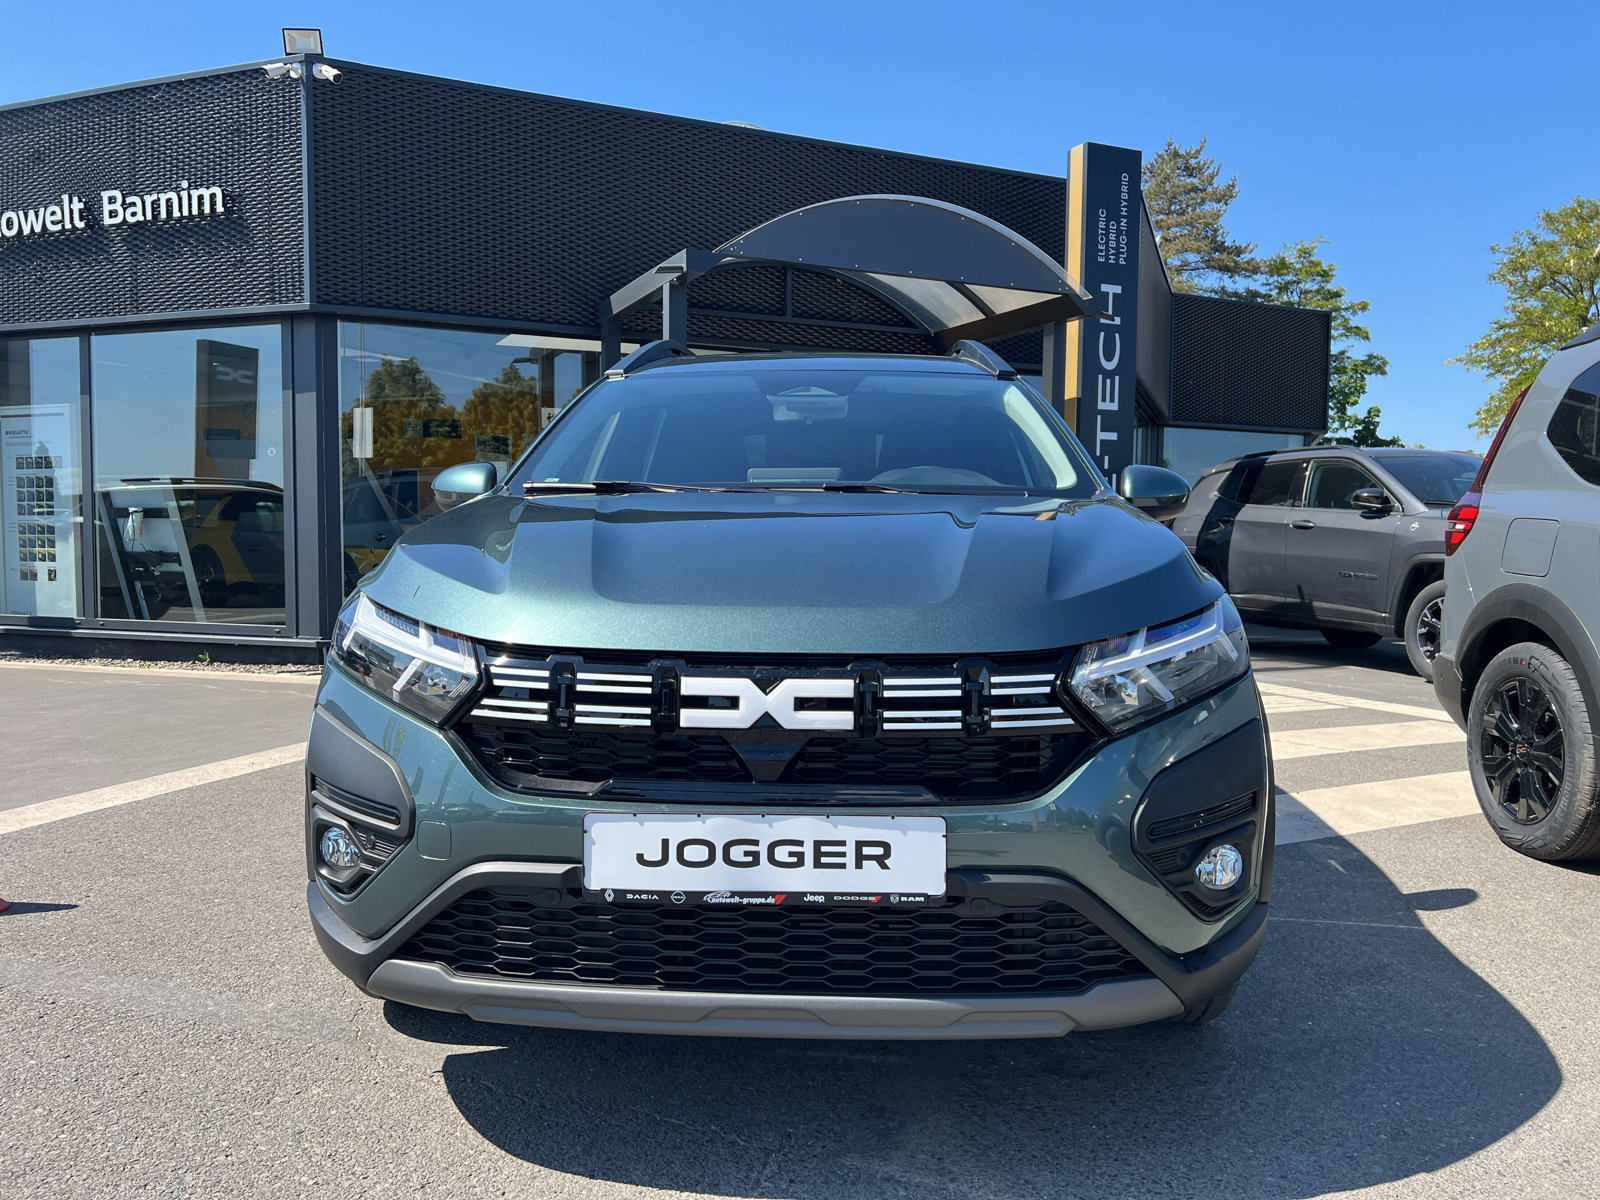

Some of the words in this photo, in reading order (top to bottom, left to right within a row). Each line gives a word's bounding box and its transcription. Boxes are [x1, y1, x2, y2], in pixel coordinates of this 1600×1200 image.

[0, 194, 85, 237] owelt
[100, 180, 225, 226] Barnim
[1120, 172, 1129, 216] HYBRID
[1097, 208, 1107, 263] ELECTRIC
[1108, 220, 1117, 264] HYBRID
[1119, 218, 1128, 265] PLUG-IN
[635, 837, 892, 870] JOGGER
[803, 893, 825, 903] Jeep
